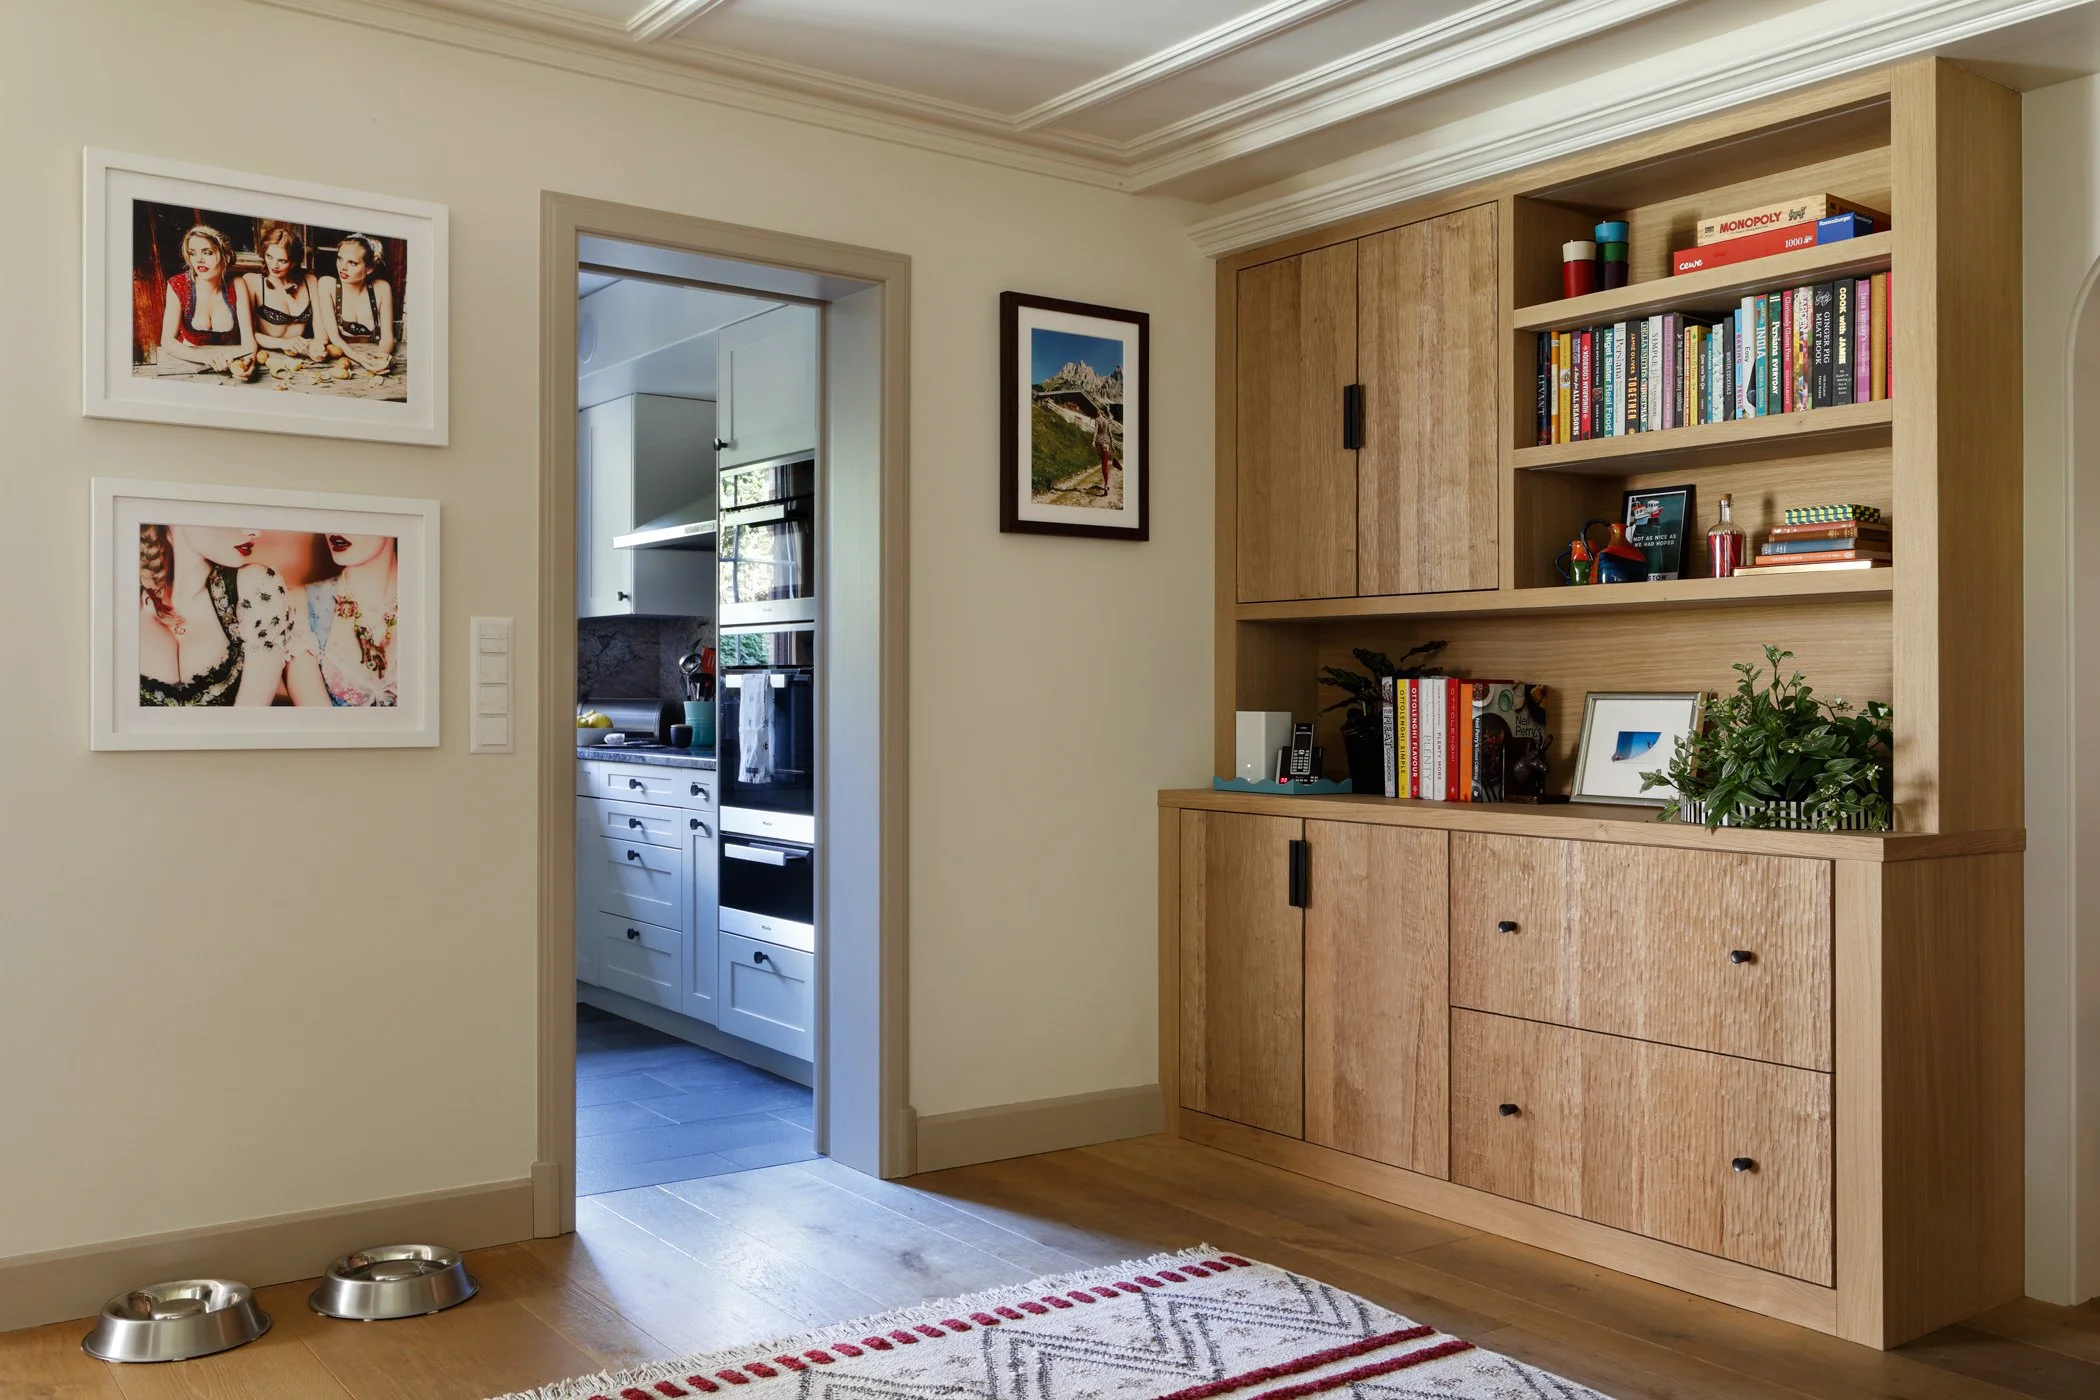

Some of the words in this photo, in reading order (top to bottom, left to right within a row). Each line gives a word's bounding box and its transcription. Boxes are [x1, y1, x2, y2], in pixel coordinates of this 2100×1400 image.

[1719, 210, 1783, 234] MONOPOLY
[1818, 215, 1852, 227] Ravensburger
[1785, 237, 1803, 248] 1000
[1679, 258, 1703, 271] cewe
[1783, 296, 1792, 327] Gloriously
[1838, 287, 1847, 314] COOK
[1772, 320, 1780, 356] Persiana
[1823, 311, 1831, 347] GINGER
[1838, 315, 1846, 335] with
[1604, 332, 1613, 355] Nigel
[1651, 332, 1659, 366] SIMPLE
[1756, 327, 1766, 359] INDIA
[1823, 348, 1831, 364] PIG
[1838, 336, 1847, 365] JAMIE
[1605, 356, 1613, 383] Slater
[1615, 338, 1624, 380] Persiana
[1605, 384, 1613, 405] Real
[1627, 376, 1637, 420] TOGETHER
[1605, 407, 1613, 431] Food
[1384, 714, 1392, 748] MEAT
[1423, 734, 1431, 781] PLENTY
